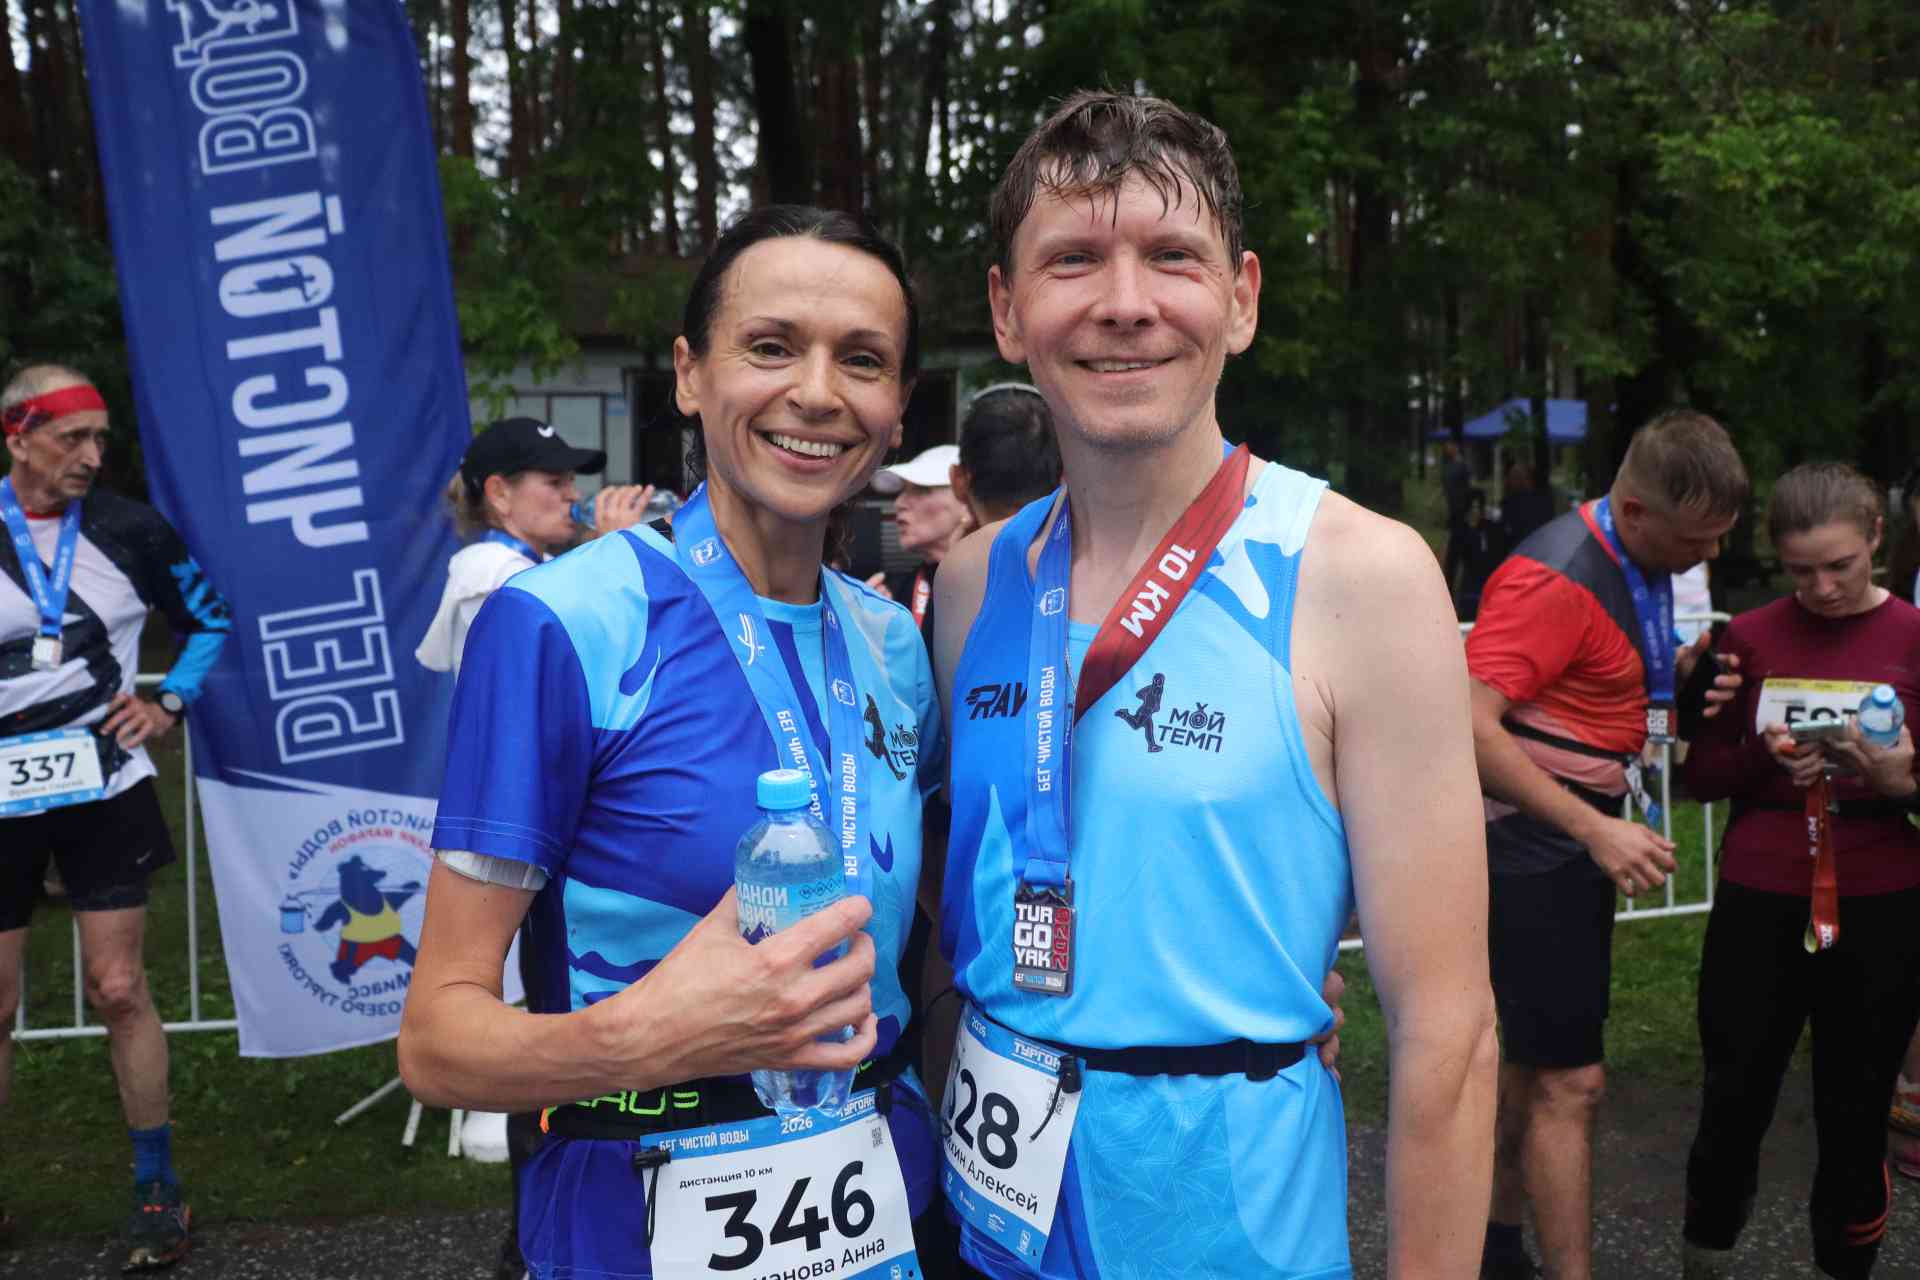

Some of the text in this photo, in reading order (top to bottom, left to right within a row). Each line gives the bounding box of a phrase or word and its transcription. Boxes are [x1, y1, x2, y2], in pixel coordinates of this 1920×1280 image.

[1158, 543, 1197, 581] 10
[1037, 665, 1056, 792] БЕГ ЧИСТОЙ ВОДЫ
[1169, 702, 1226, 733] МОЙ
[777, 709, 798, 734] БЕГ
[788, 737, 817, 789] ЧИСТ
[1158, 724, 1223, 752] ТЕМП
[8, 752, 76, 786] 337
[842, 752, 857, 793] ВОДЫ
[841, 795, 857, 848] ЧИСТОЙ
[1015, 903, 1053, 924] TUR
[1014, 922, 1053, 949] GO
[1013, 946, 1052, 969] YAK
[1013, 1041, 1062, 1070] ТУРГОЯ
[679, 1131, 718, 1150] ЧИСТОЙ
[720, 1128, 750, 1145] ВОДЫ
[780, 1116, 814, 1135] 2026
[679, 1167, 773, 1189] дистанция 10 км
[968, 1160, 1039, 1215] Алексей
[705, 1160, 875, 1271] 346
[753, 1238, 886, 1280] анова Анна
